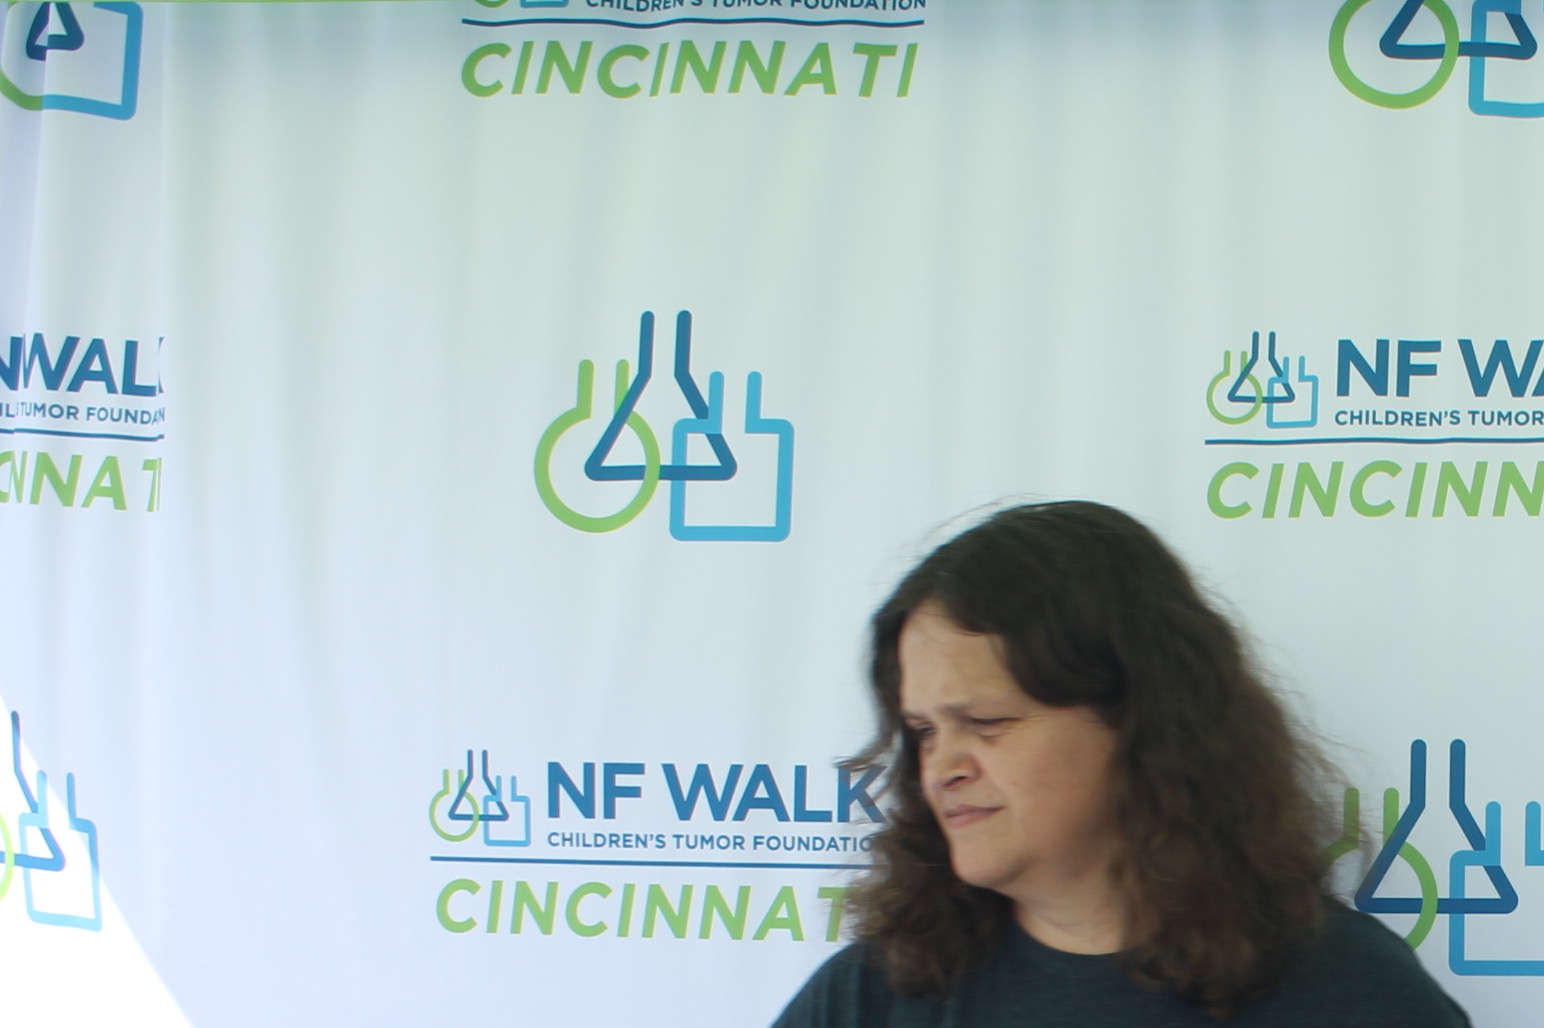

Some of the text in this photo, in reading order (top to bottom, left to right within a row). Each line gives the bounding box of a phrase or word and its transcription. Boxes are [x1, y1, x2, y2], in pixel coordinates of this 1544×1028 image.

[461, 40, 918, 98] CINCINNATI
[1336, 339, 1442, 397] NF
[1335, 410, 1461, 427] CHILDREN'S
[1467, 410, 1544, 426] TUMOR
[547, 762, 887, 824] NF WALK
[547, 831, 873, 853] CHILDREN'S TUMOR FOUNDATIO
[436, 878, 857, 942] CINCINNAT
